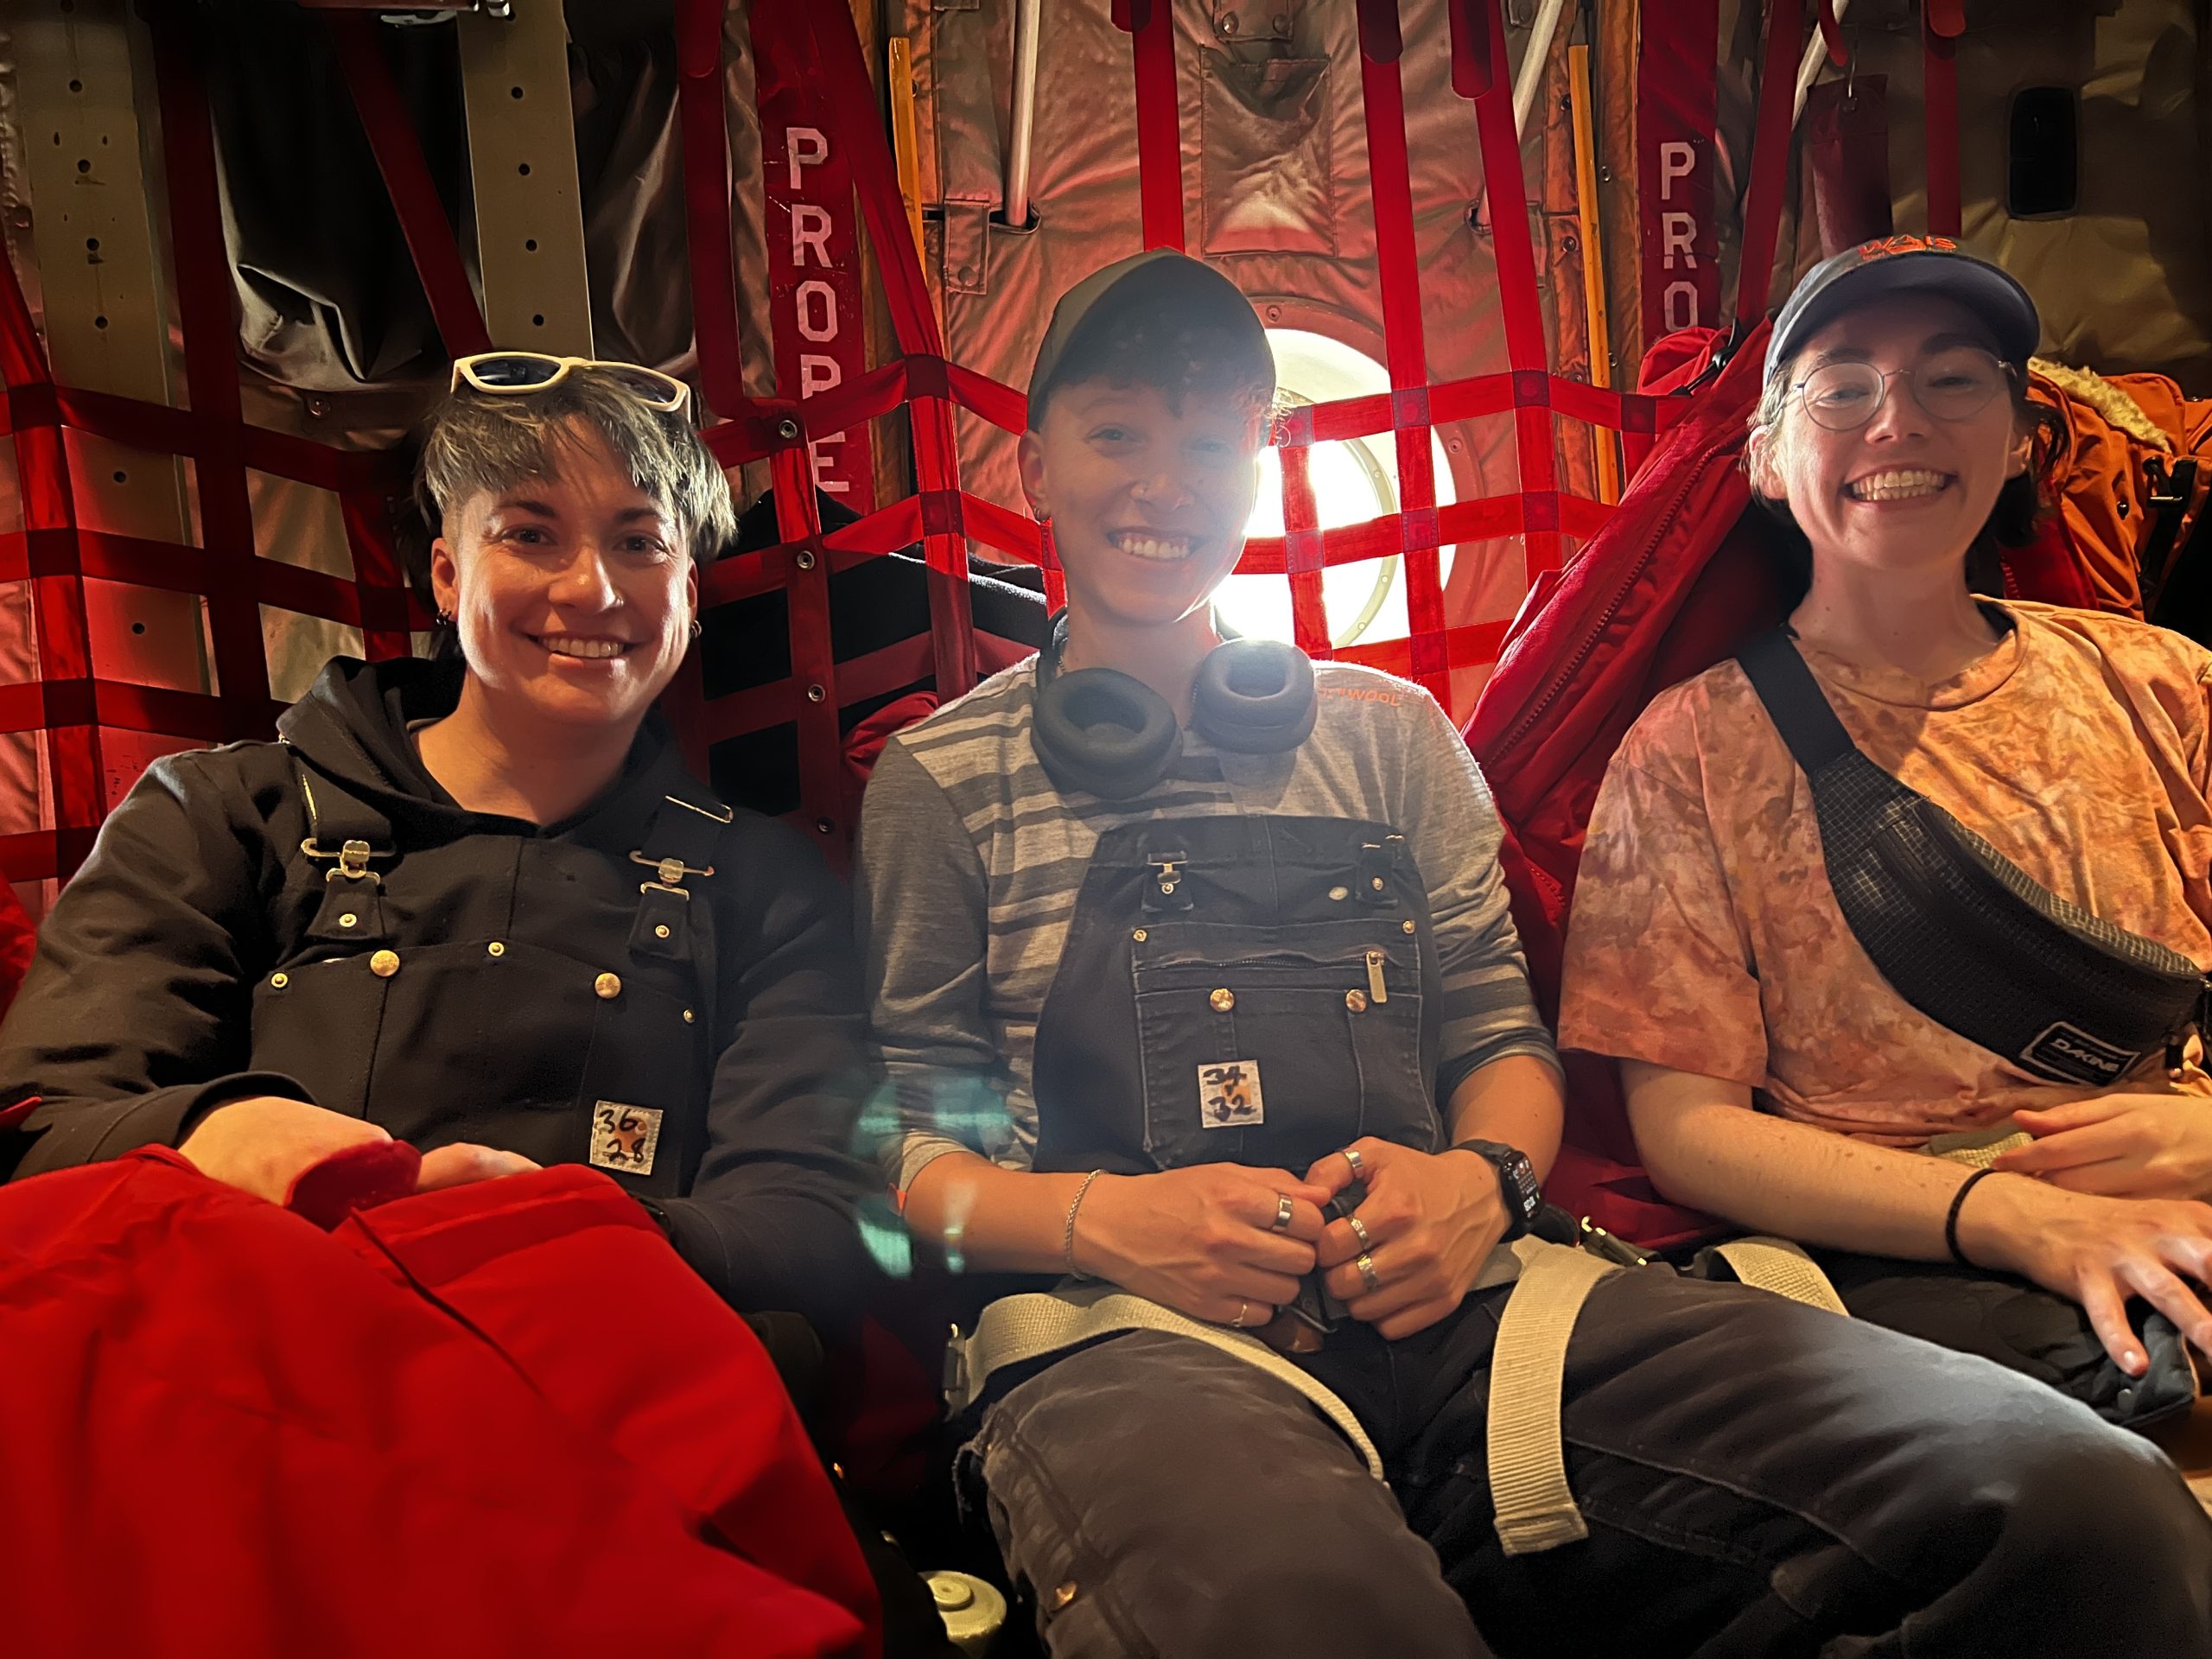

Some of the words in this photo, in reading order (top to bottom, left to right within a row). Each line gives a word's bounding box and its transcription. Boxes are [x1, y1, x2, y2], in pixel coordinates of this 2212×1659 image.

[1660, 142, 1699, 333] PRO
[786, 127, 850, 493] PROPE
[2050, 1038, 2120, 1072] DAKINE
[1203, 1065, 1248, 1085] 34
[599, 1109, 639, 1134] 36
[1208, 1094, 1257, 1122] 32
[607, 1137, 646, 1163] 28
